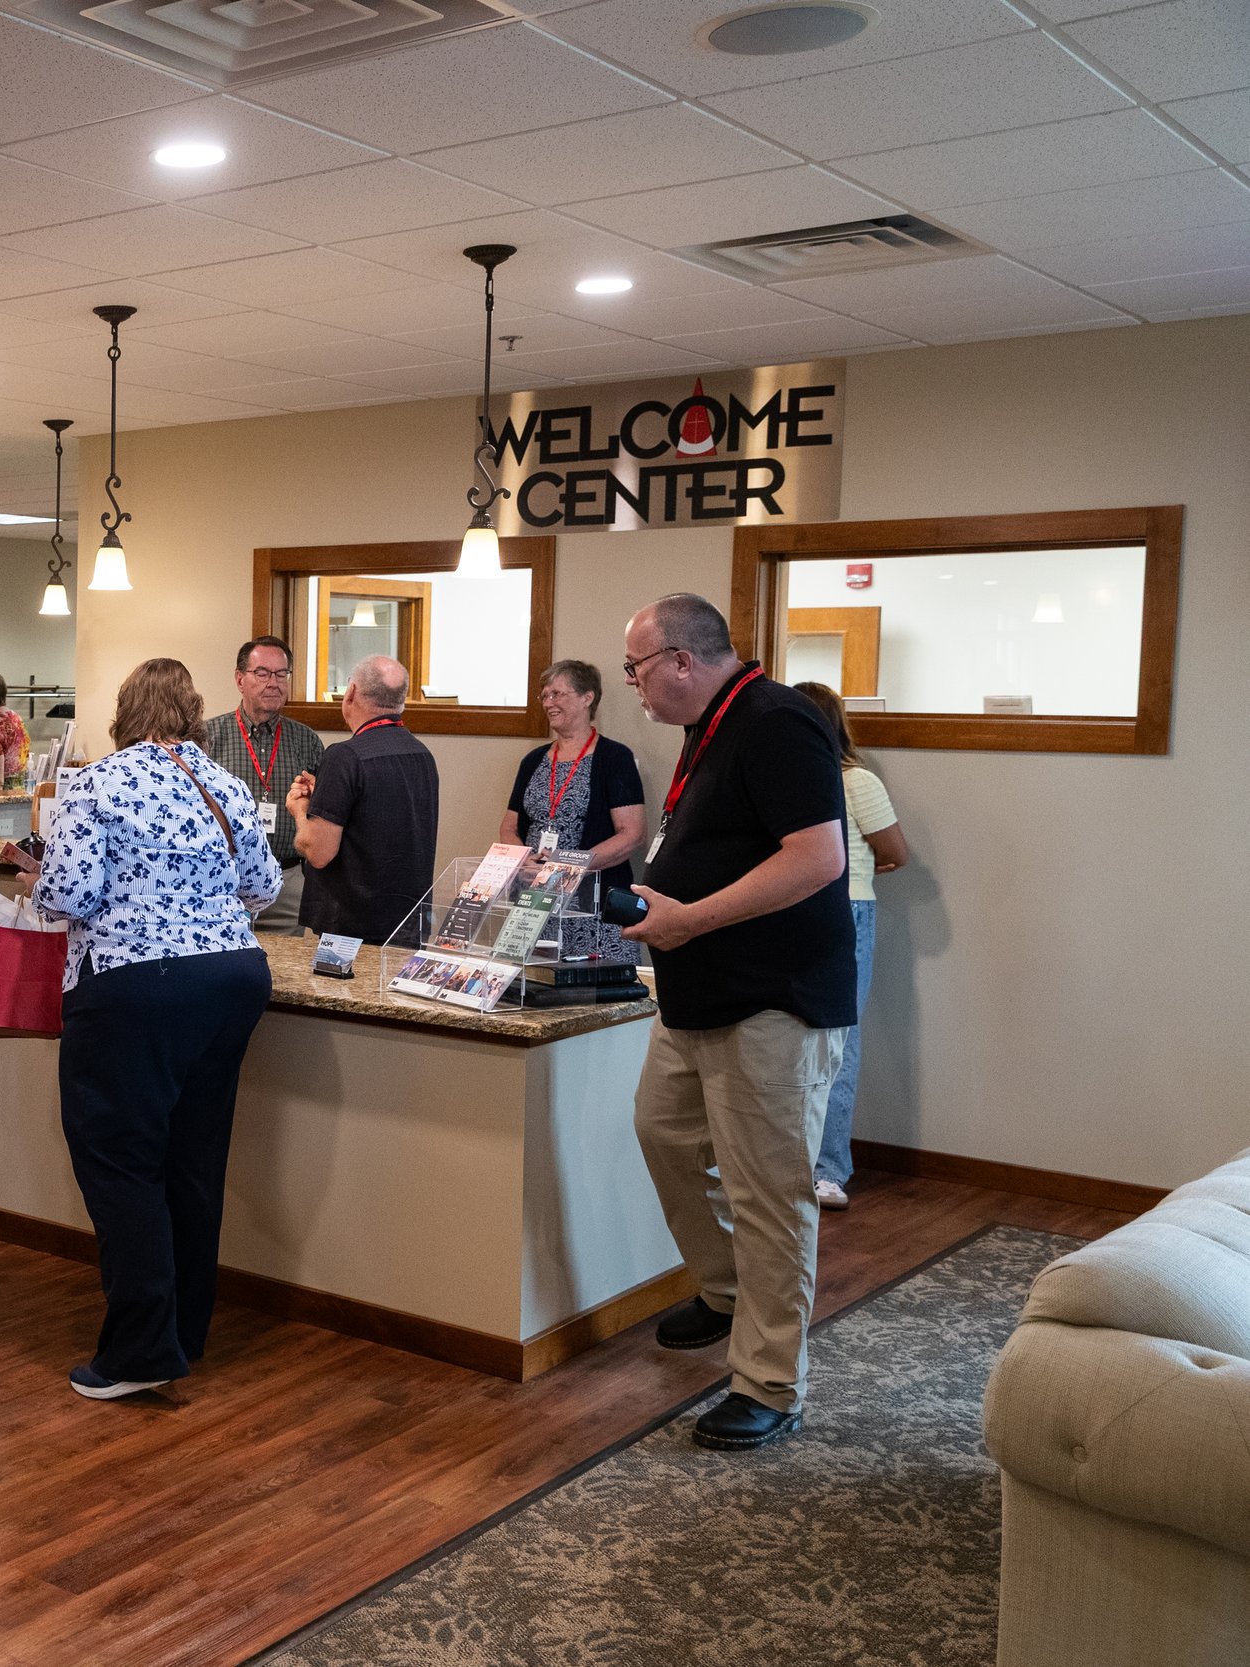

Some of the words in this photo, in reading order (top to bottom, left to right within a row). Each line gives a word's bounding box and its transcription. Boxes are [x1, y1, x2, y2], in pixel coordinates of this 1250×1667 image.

[479, 385, 835, 467] WELCOME
[516, 457, 785, 527] CENTER
[569, 852, 590, 860] GROUPS
